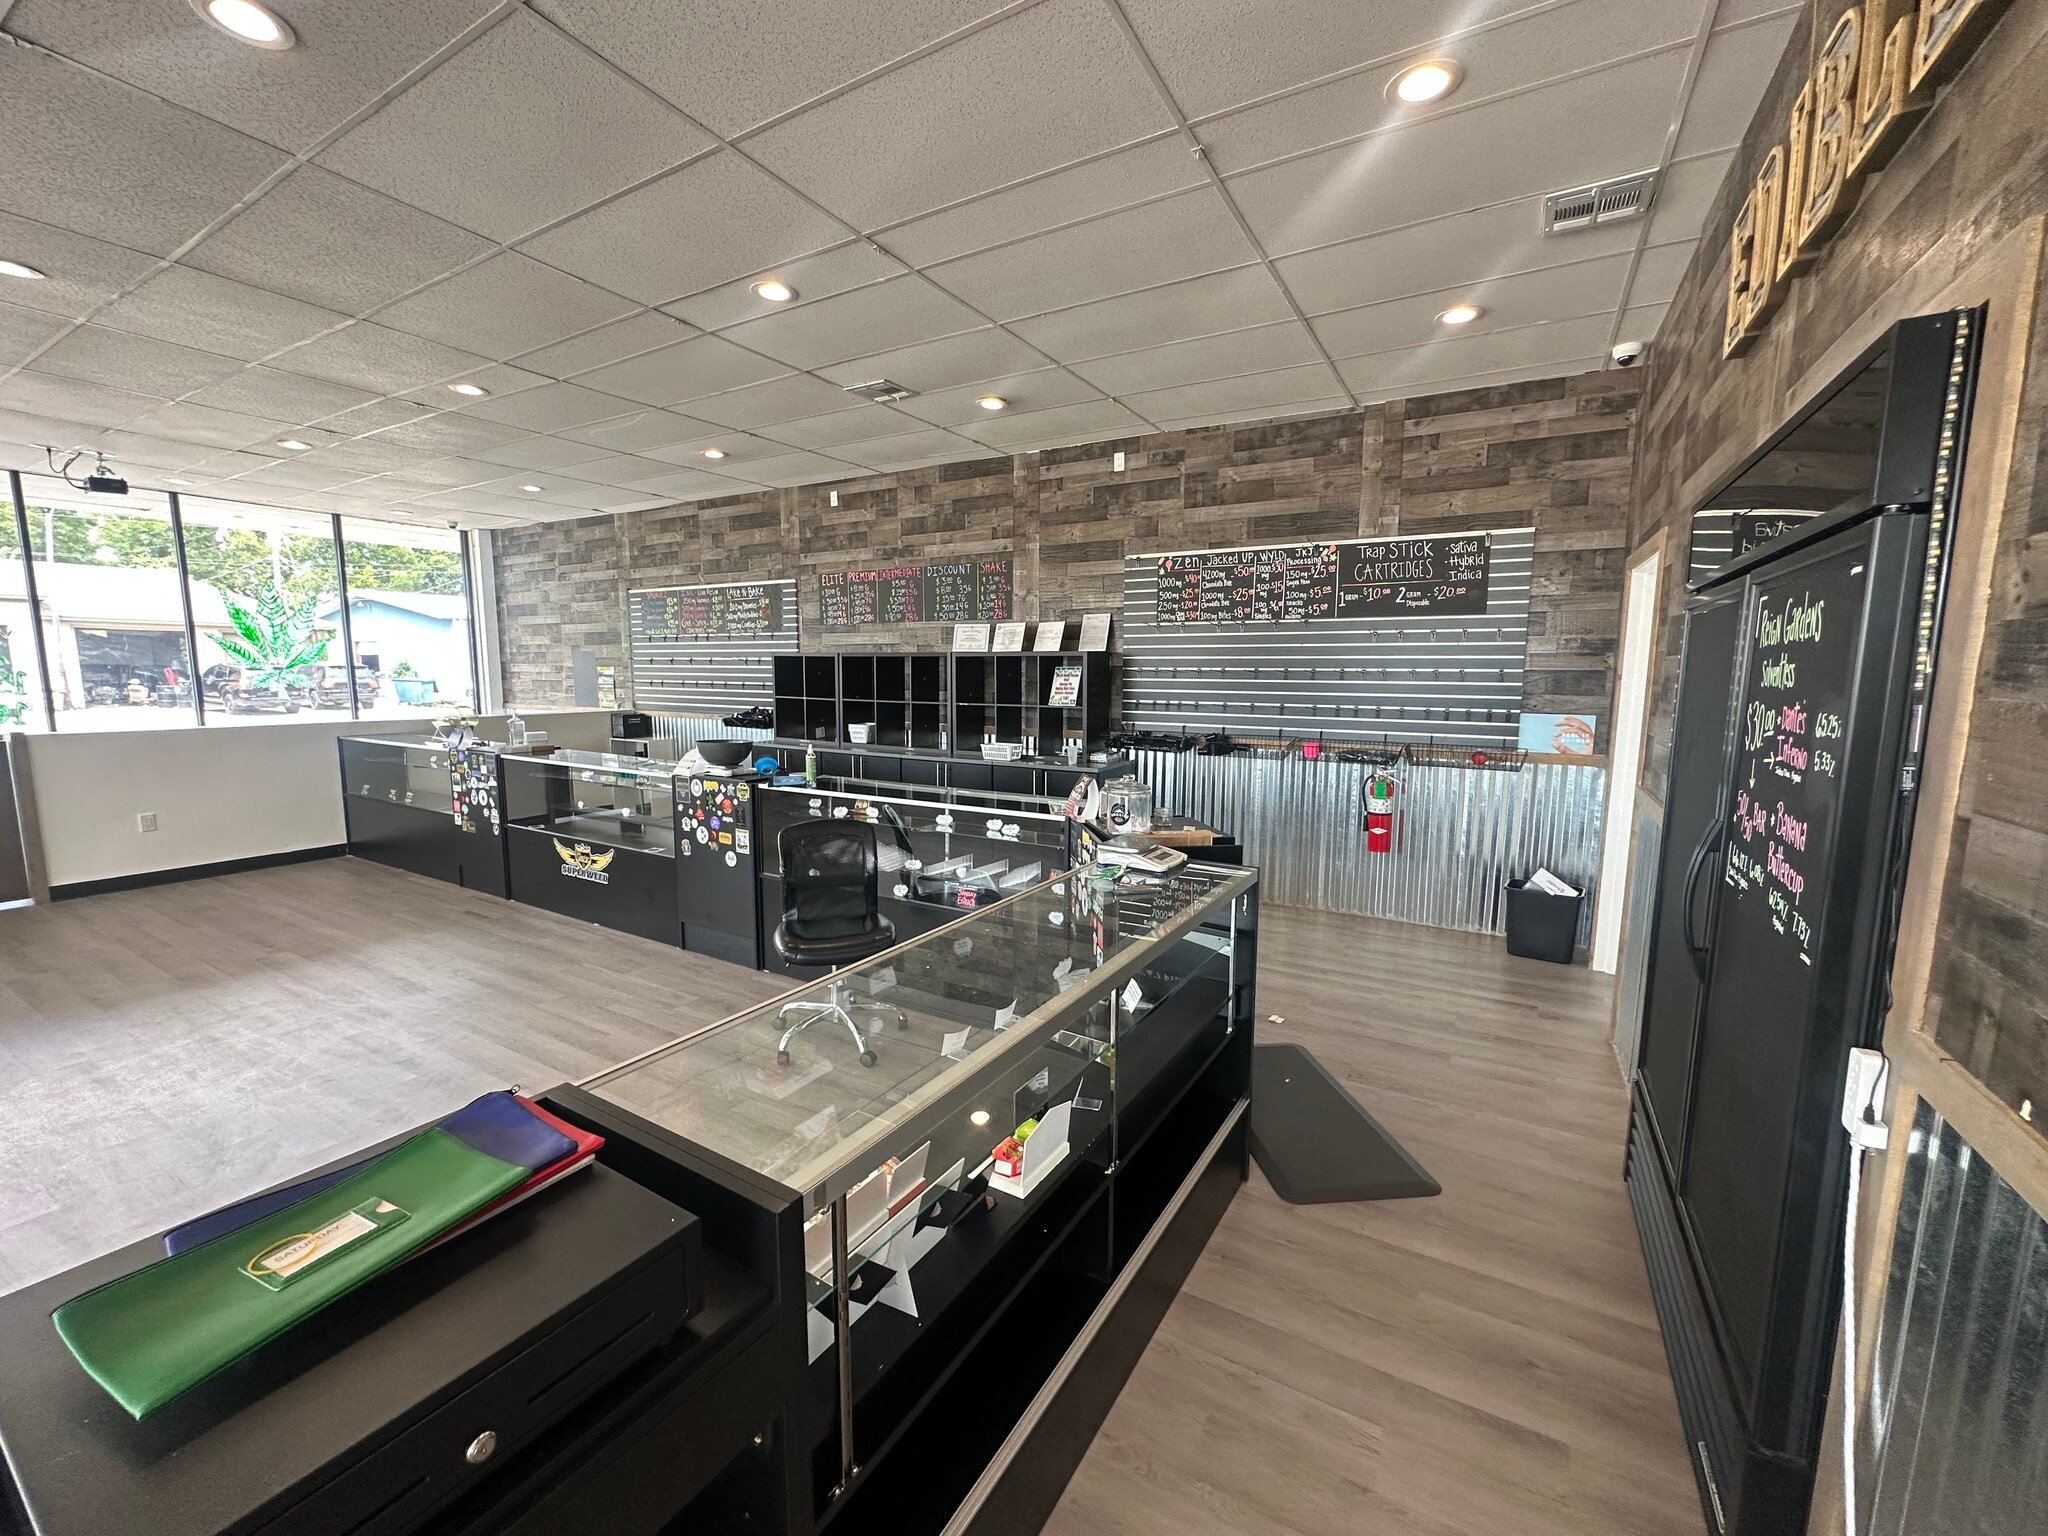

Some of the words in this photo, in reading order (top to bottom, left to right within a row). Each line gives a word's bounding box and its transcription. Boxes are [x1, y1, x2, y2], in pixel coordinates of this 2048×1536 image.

[927, 563, 971, 577] DISCOUNT
[980, 561, 1007, 573] SHAKE
[1354, 559, 1434, 582] CARTRIDGES
[821, 573, 844, 586] ELITE
[849, 571, 876, 582] PREMIUM
[879, 568, 922, 581] INTERMEDIATE
[1449, 569, 1482, 581] Indica
